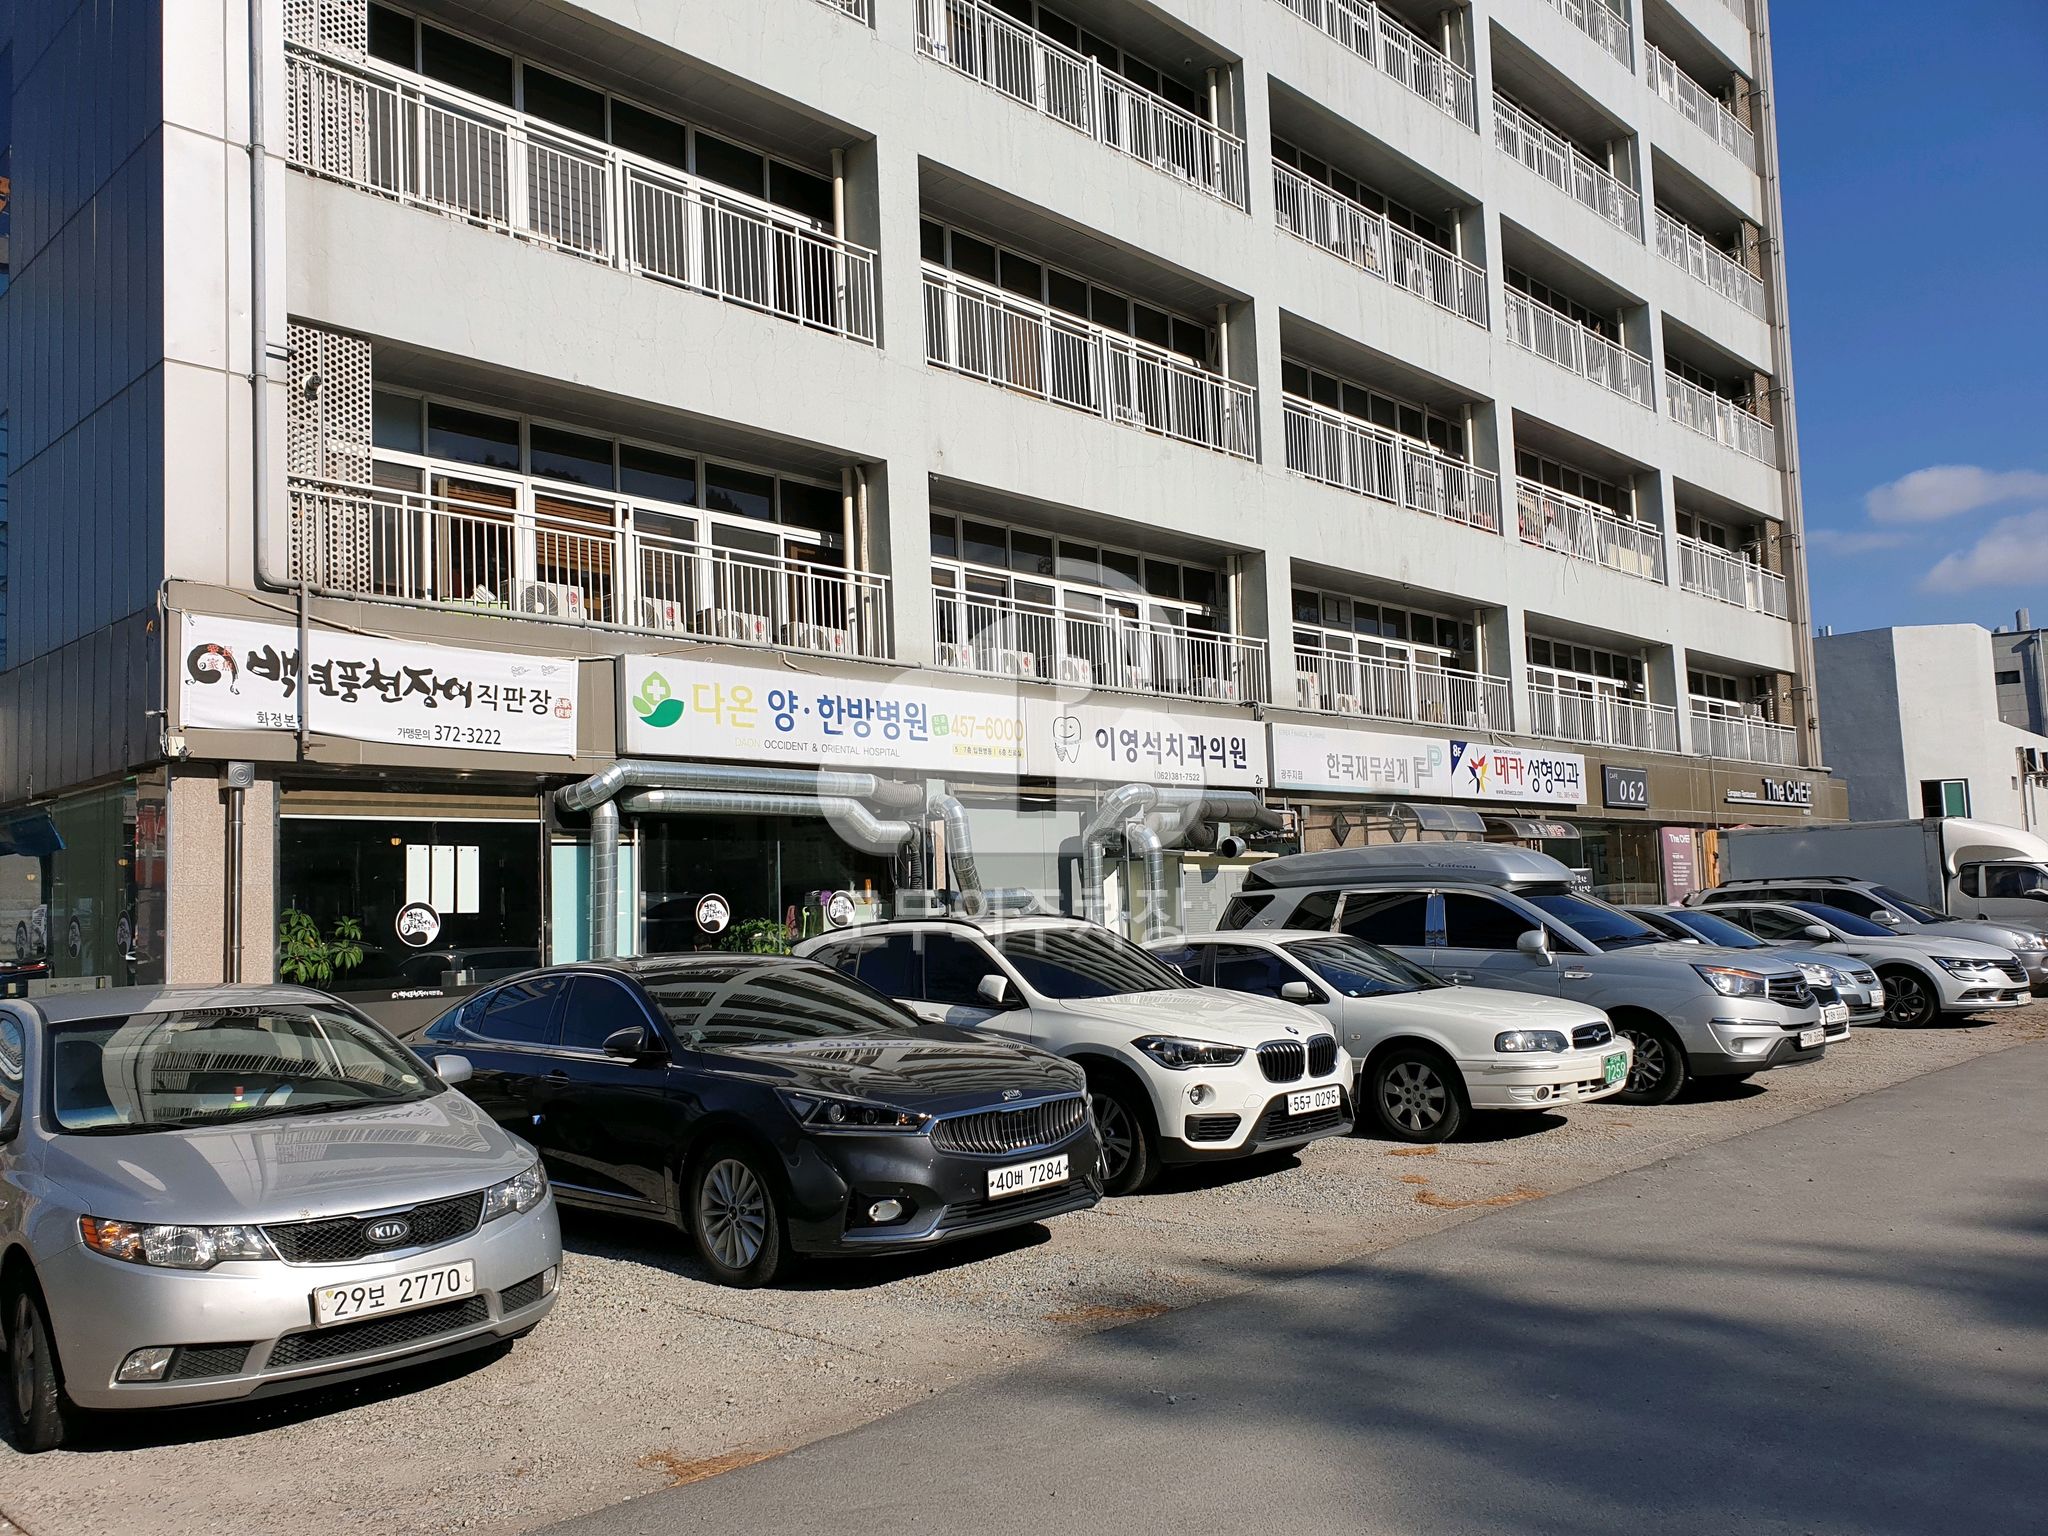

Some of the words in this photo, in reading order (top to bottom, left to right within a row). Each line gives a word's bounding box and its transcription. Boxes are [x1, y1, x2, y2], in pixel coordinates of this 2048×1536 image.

[477, 685, 552, 715] 직판장
[692, 682, 758, 728] 다온
[256, 711, 303, 729] 화정본
[951, 714, 1024, 742] 457-6000
[398, 727, 431, 740] 가맹문의
[434, 725, 502, 745] 372-3222
[764, 739, 808, 752] OCCIDENT
[812, 742, 819, 752] &
[822, 744, 860, 755] ORIENTAL
[863, 747, 901, 758] HOSPITAL
[1095, 726, 1248, 770] 이영석치과의원
[1452, 744, 1463, 757] 8F
[1154, 770, 1201, 782] (062)381-7522
[1326, 752, 1408, 784] 한국재무설계
[1494, 755, 1525, 786] 메카
[1527, 757, 1580, 793] 성형외과
[1609, 772, 1618, 780] CAFE
[1255, 774, 1264, 785] 2F
[1764, 778, 1785, 801] The
[1786, 780, 1812, 802] CHEF
[1619, 779, 1645, 802] 062
[1605, 1062, 1625, 1081] 7259
[1315, 1089, 1337, 1107] 0295
[1029, 1160, 1062, 1184] 7284
[374, 1226, 401, 1239] KIA
[333, 1285, 385, 1317] 29보
[399, 1268, 461, 1303] 2770
